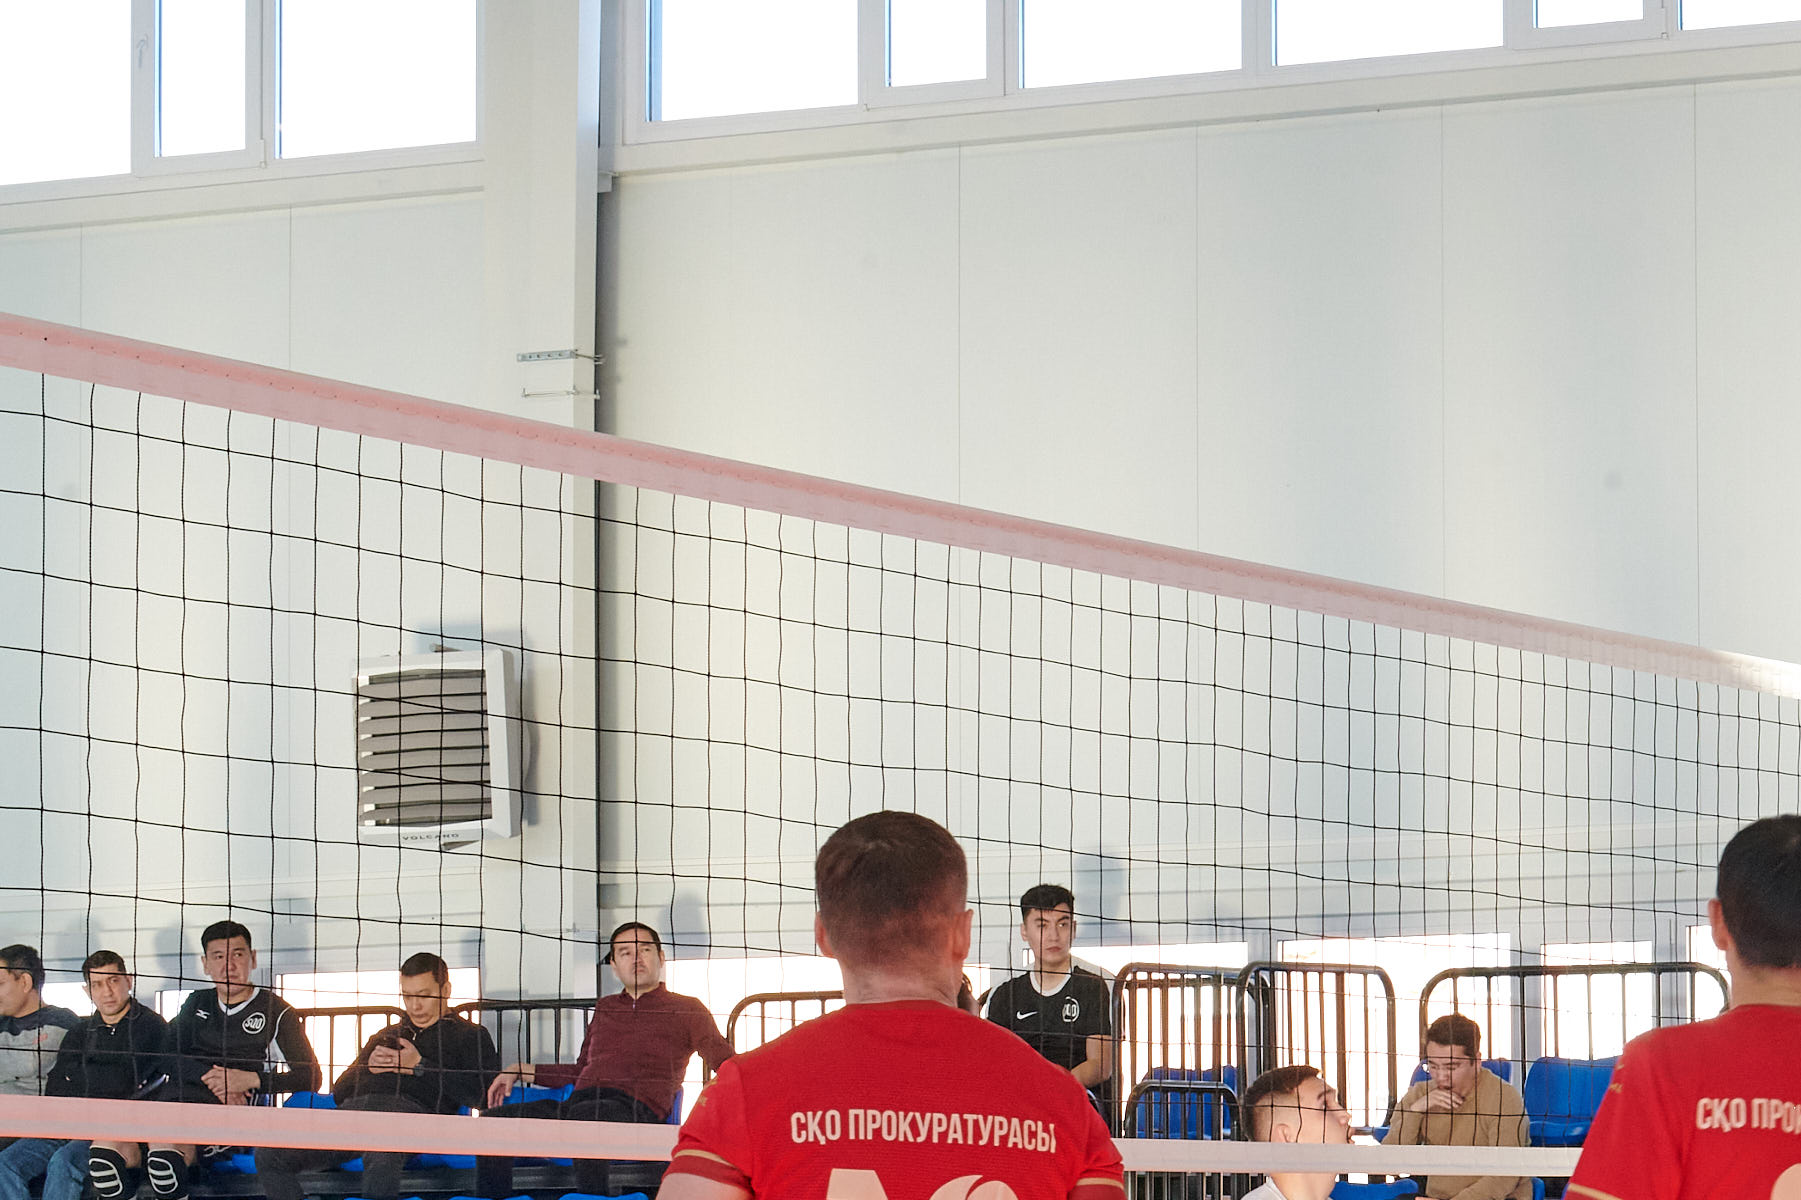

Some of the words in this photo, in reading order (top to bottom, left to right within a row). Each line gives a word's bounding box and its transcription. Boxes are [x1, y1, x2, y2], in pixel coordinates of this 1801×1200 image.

[790, 1109, 842, 1145] СҚО
[848, 1108, 1057, 1154] ПРОКУРАТУРАСЫ
[1696, 1097, 1748, 1133] СҚО
